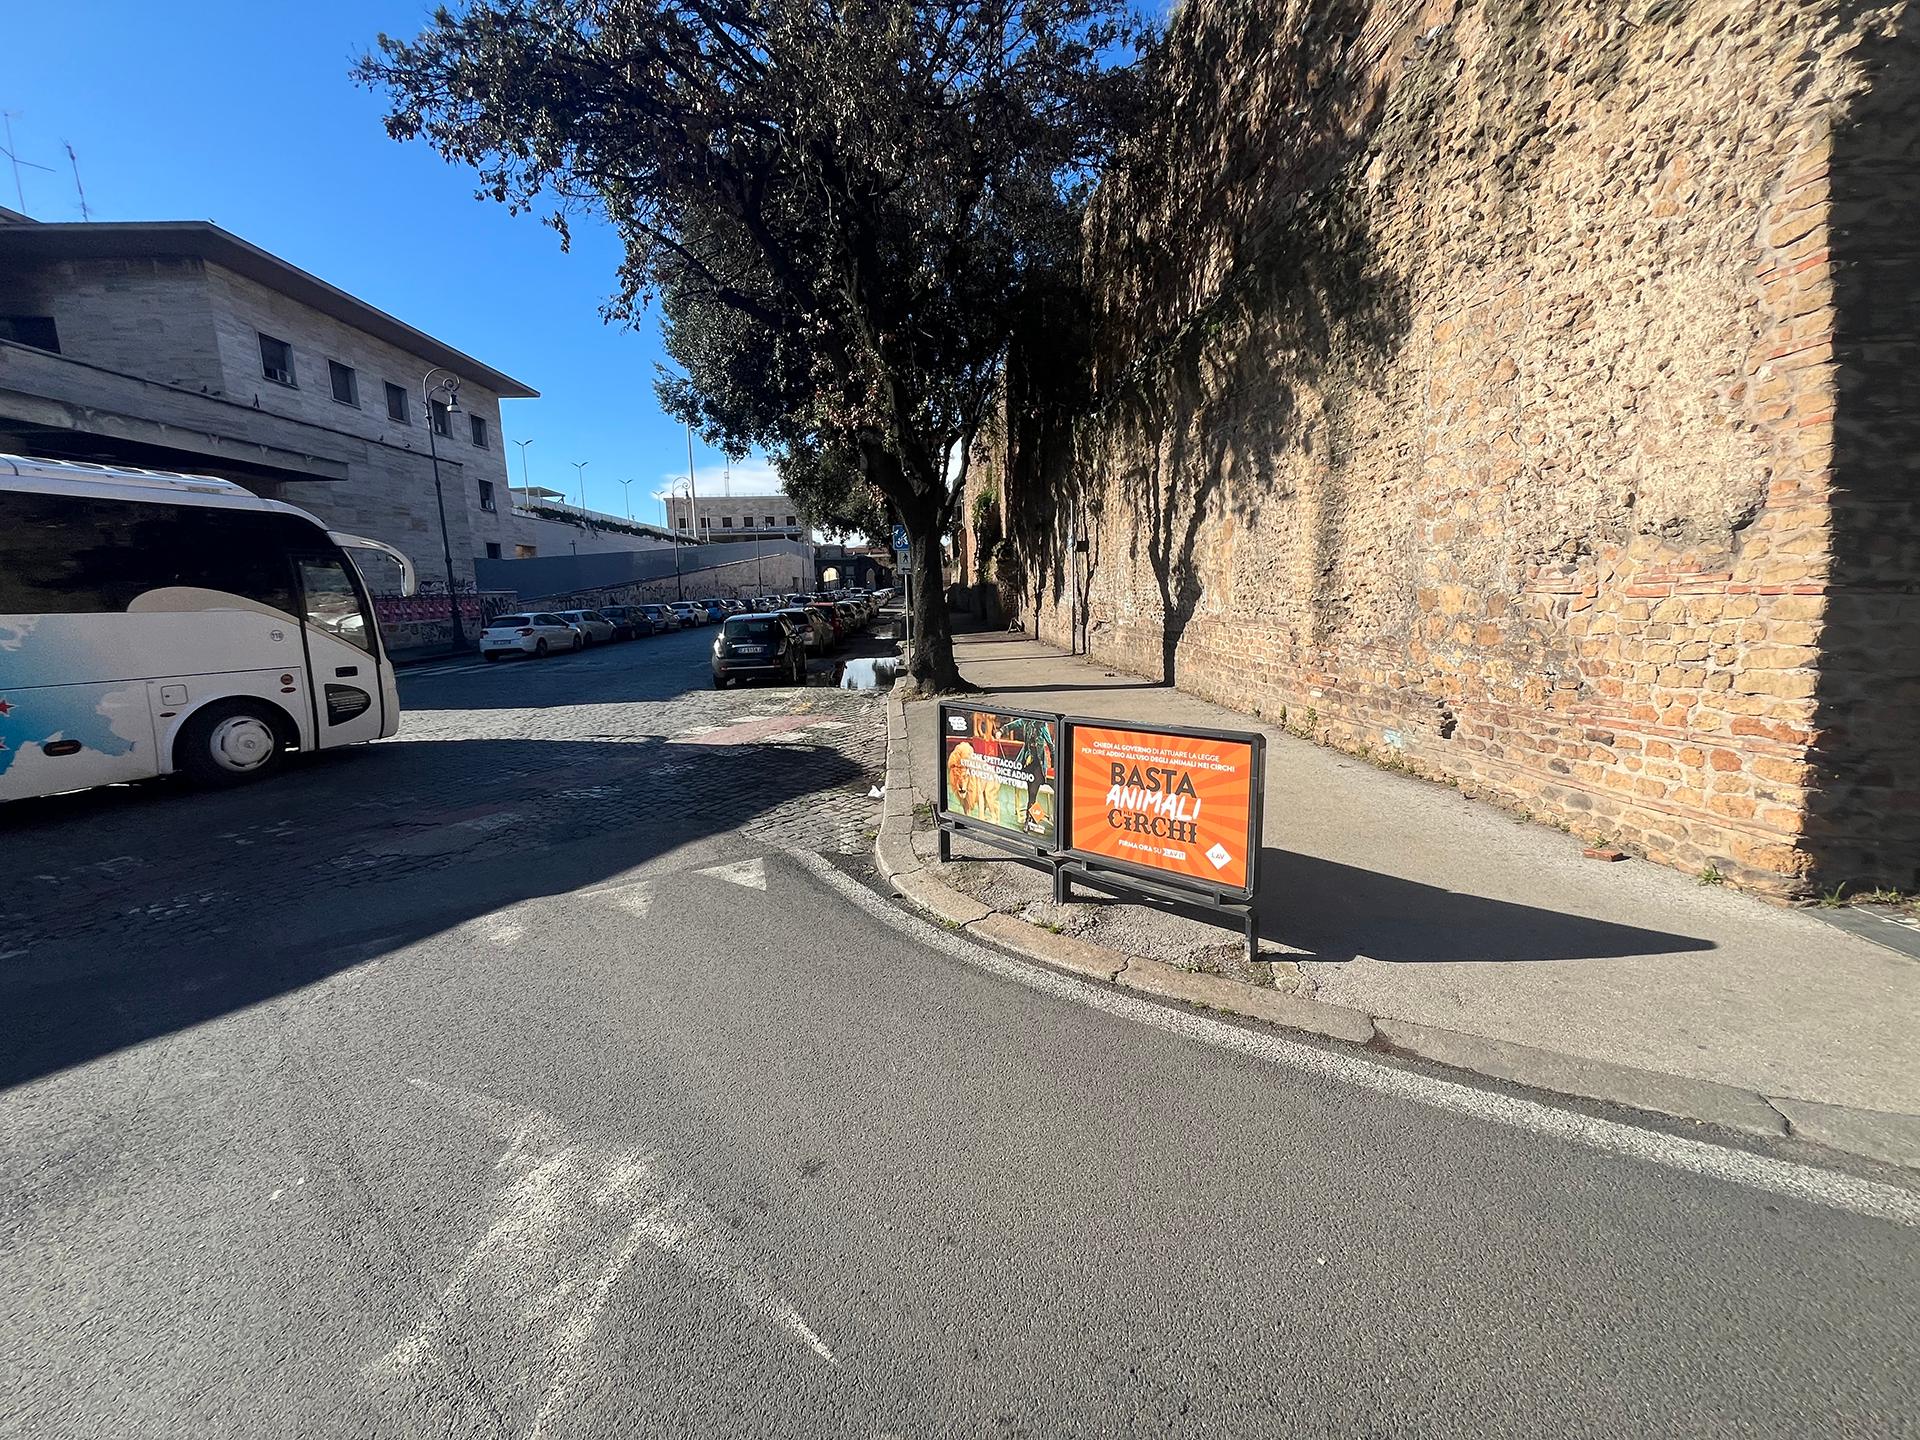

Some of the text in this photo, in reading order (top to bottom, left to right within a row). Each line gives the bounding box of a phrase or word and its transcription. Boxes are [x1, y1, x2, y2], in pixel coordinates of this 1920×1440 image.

[971, 752, 1023, 770] CHE SPETTACOLO
[1093, 741, 1113, 750] CHIEDI
[1112, 743, 1121, 751] AL
[1121, 744, 1152, 754] GOVERNO
[1159, 749, 1188, 758] ATTUARE
[1188, 751, 1196, 759] LA
[1197, 753, 1220, 763] LEGGE
[1106, 751, 1126, 759] ADDIO
[1126, 753, 1150, 761] ALL'USO
[1150, 756, 1168, 764] DEGLI
[1169, 758, 1197, 767] ANIMALI
[1197, 761, 1209, 769] NEI
[1210, 763, 1235, 773] CIRCHI
[970, 769, 994, 781] QUESTA
[996, 774, 1028, 789] TORTURA
[984, 764, 996, 773] CHE
[996, 766, 1011, 777] DICE
[1011, 770, 1035, 782] ADDIO
[1111, 762, 1197, 799] BASTA
[1105, 783, 1202, 821] ANIMALI
[1107, 808, 1198, 844] CIRCHI
[1118, 839, 1139, 849] FIRMA
[1138, 843, 1153, 852] ORA
[1211, 852, 1225, 860] LAV
